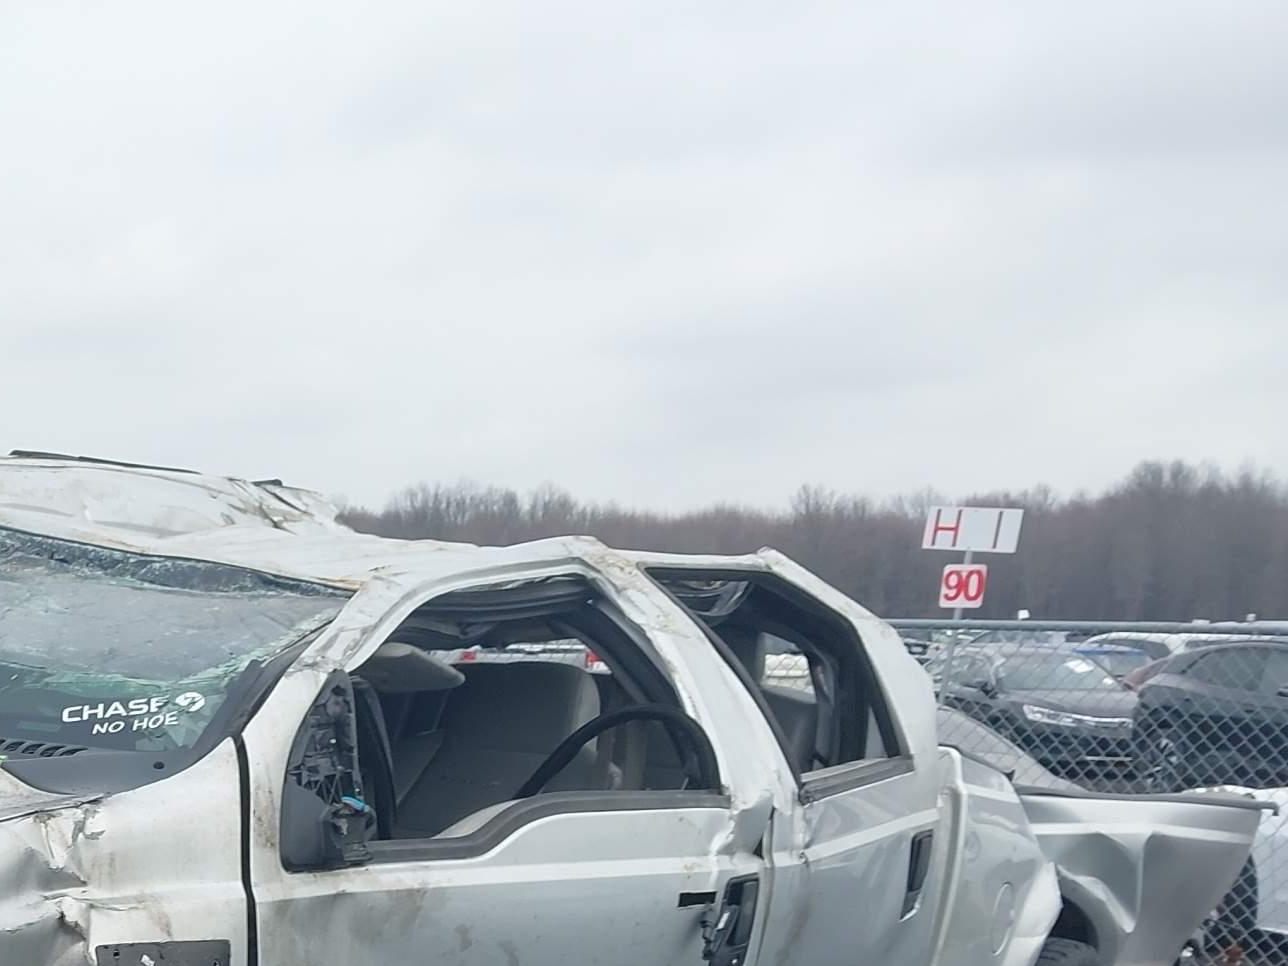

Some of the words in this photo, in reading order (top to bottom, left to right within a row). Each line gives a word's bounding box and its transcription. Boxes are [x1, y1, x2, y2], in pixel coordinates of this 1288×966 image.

[931, 508, 963, 547] H
[943, 569, 985, 602] 90
[91, 721, 126, 735] NO
[131, 710, 180, 732] HOE
